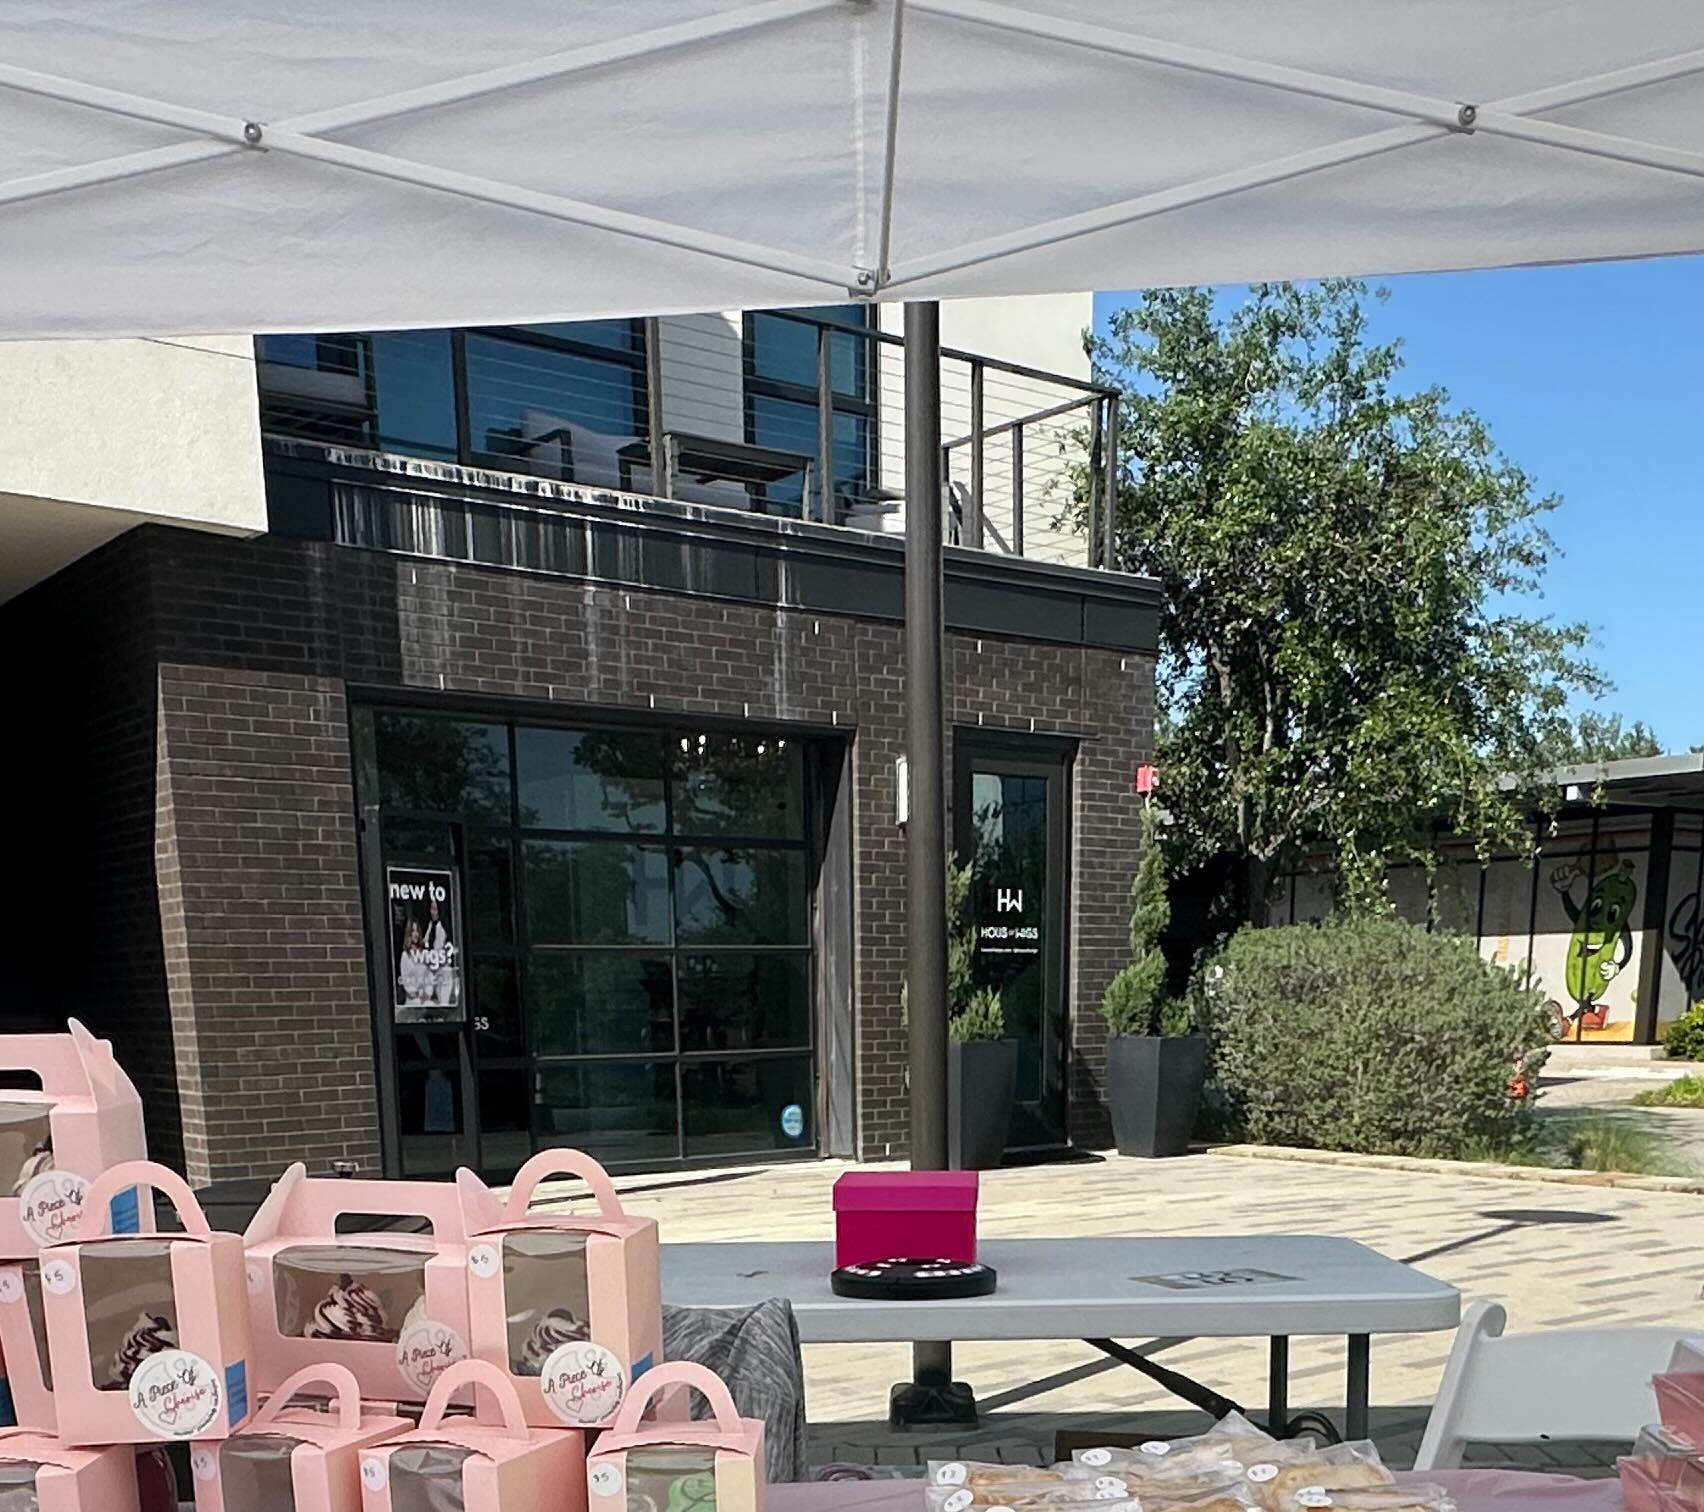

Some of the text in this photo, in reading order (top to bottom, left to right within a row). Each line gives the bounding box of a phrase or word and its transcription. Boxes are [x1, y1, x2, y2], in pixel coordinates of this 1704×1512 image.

[389, 881, 446, 902] new to
[997, 888, 1023, 912] HW
[980, 926, 1008, 939] HOUS
[1015, 926, 1039, 939] WIGS
[410, 942, 454, 970] wigs?
